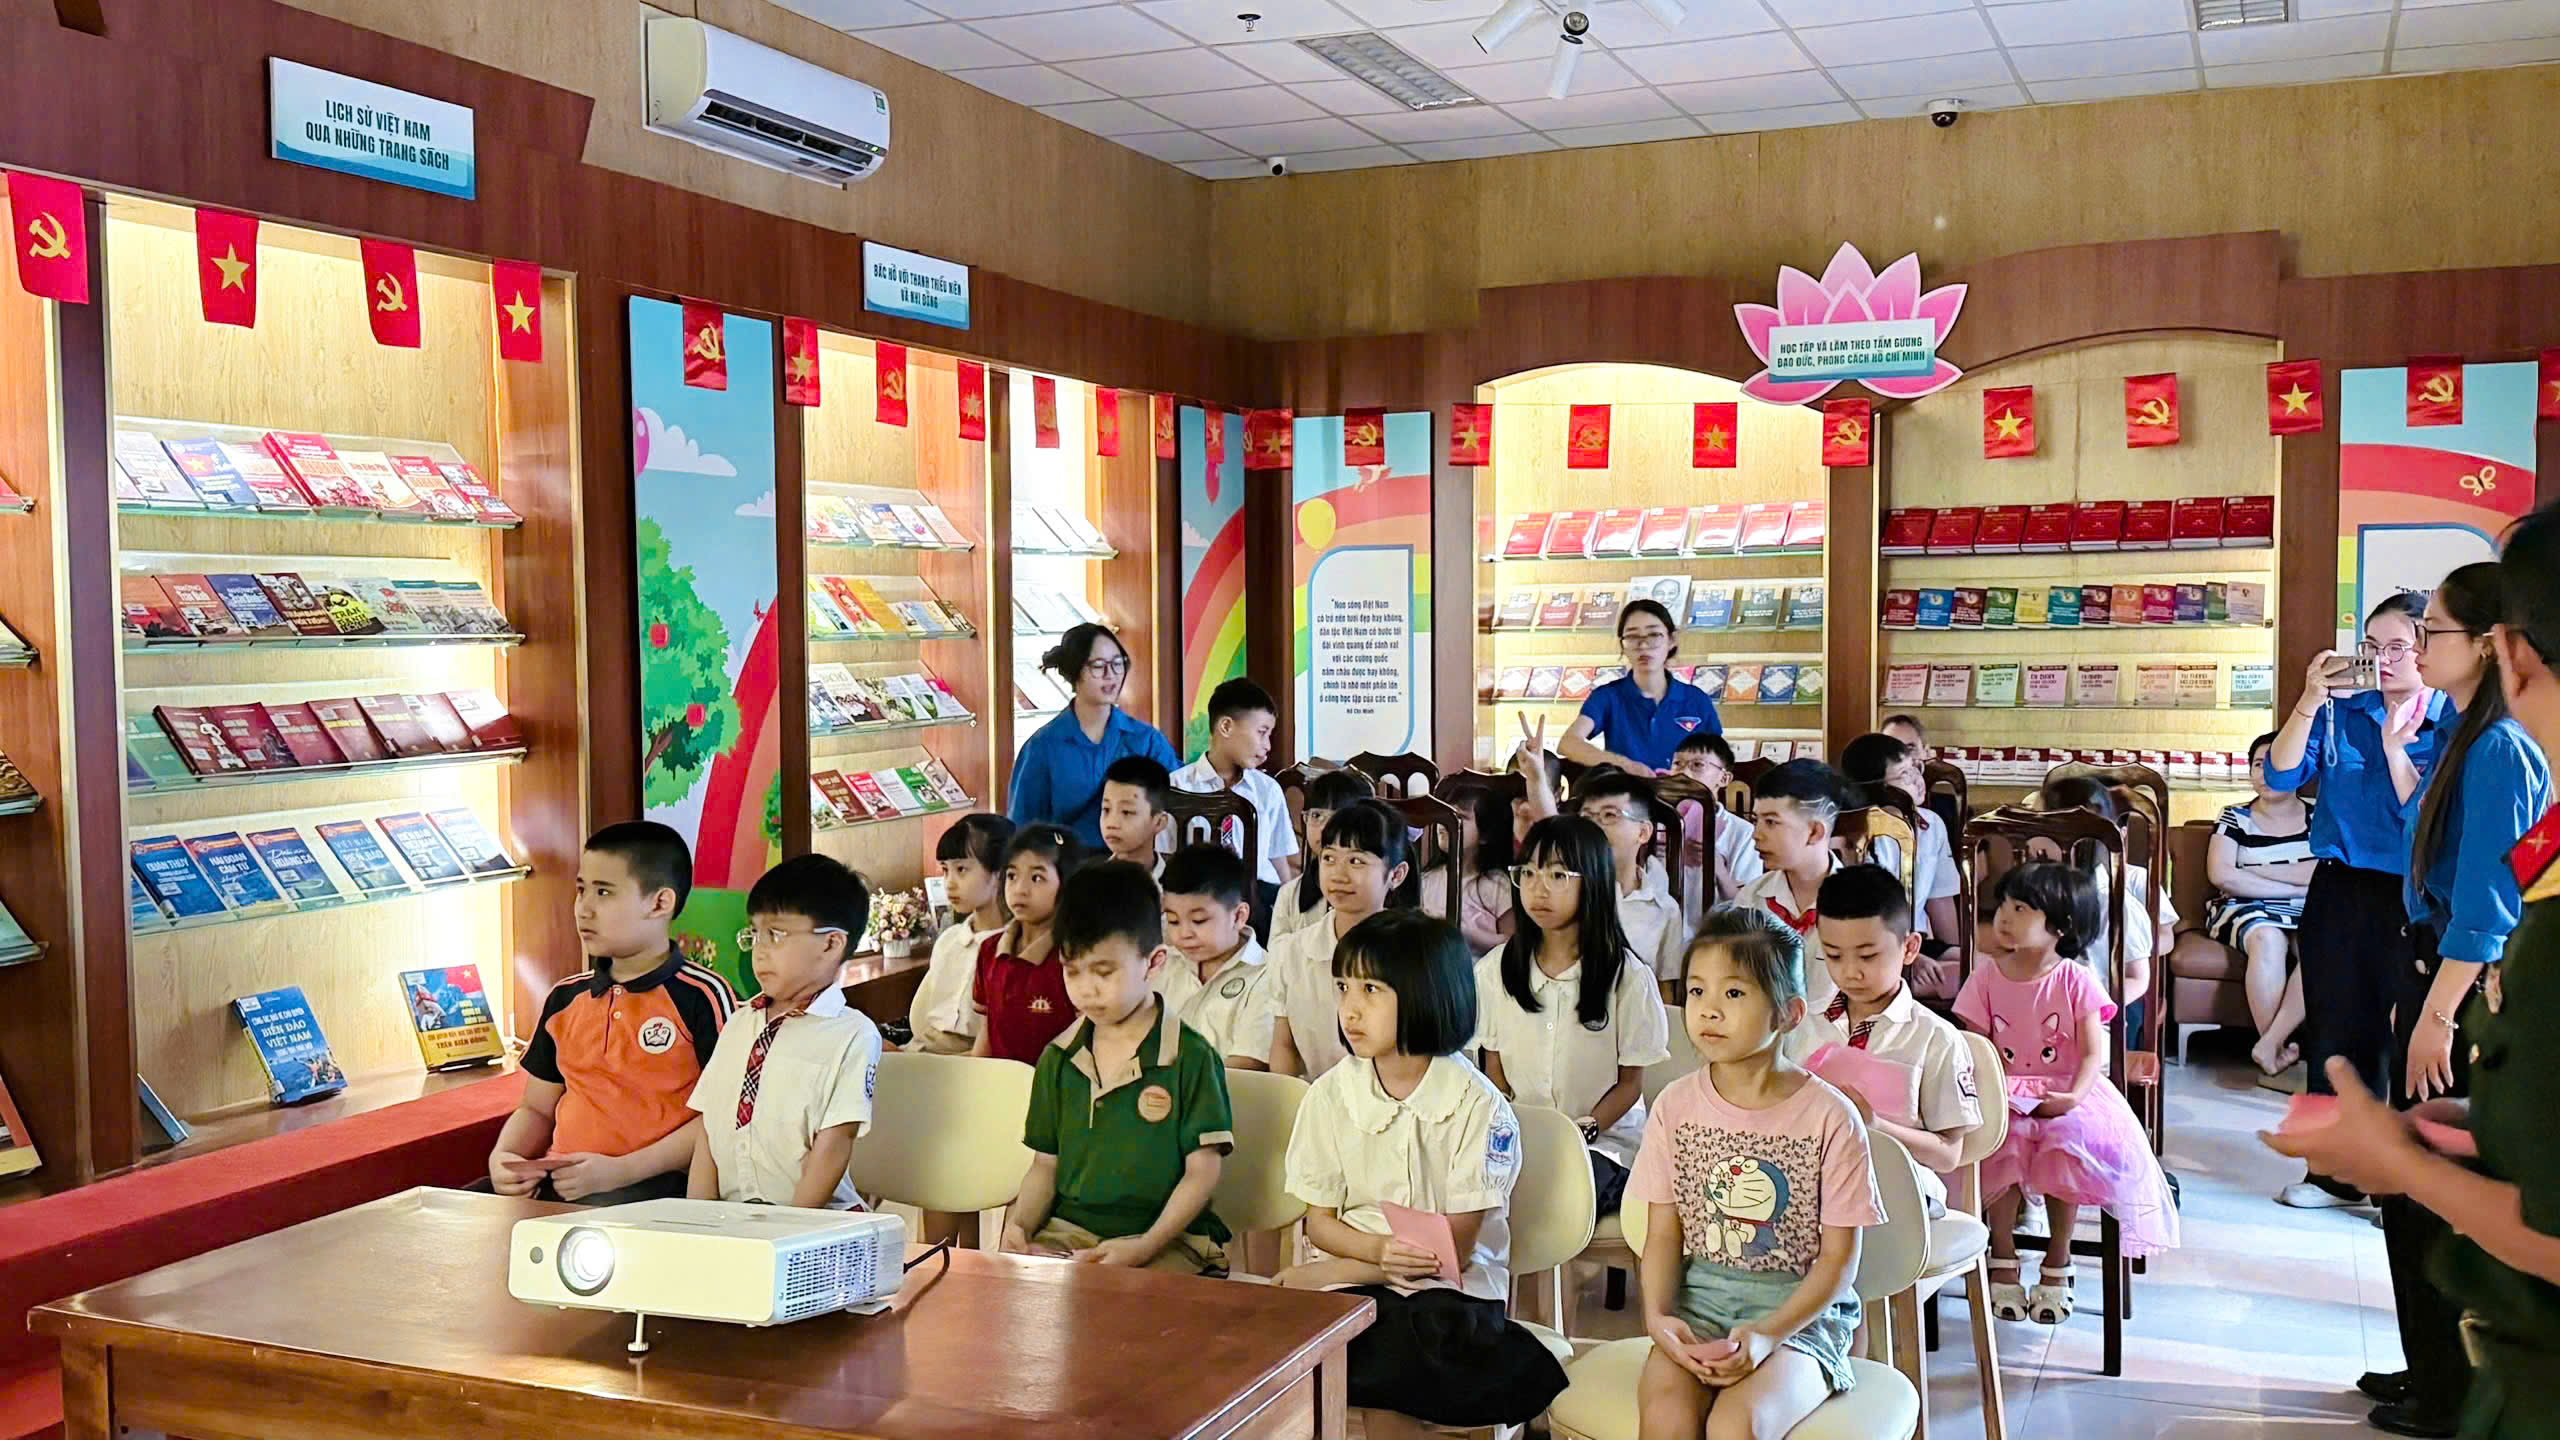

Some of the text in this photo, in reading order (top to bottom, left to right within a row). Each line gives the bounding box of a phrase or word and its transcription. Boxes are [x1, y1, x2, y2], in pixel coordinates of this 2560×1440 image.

[326, 100, 430, 141] LỊCH SỬ VIỆT NAM
[306, 122, 449, 170] QUA NHỮNG TRANG SÁCH
[874, 263, 961, 296] BÁC HỒ VỚI THANH THIẾU NIÊN
[901, 287, 938, 309] VÀ NHI ĐỒNG
[1780, 335, 1922, 354] HỌC TẬP VÀ LÀM THEO TẤM GƯƠNG
[1778, 349, 1925, 368] ĐẠO ĐỨC, PHONG CÁCH HỒ CHÍ MINH
[1363, 600, 1374, 611] Việt
[1375, 600, 1389, 609] Nam
[1372, 614, 1382, 623] hay
[1342, 627, 1352, 636] Việt
[1354, 627, 1367, 635] Nam
[1347, 641, 1364, 651] quang
[1368, 668, 1377, 677] hay
[266, 1029, 312, 1048] VIỆT NAM
